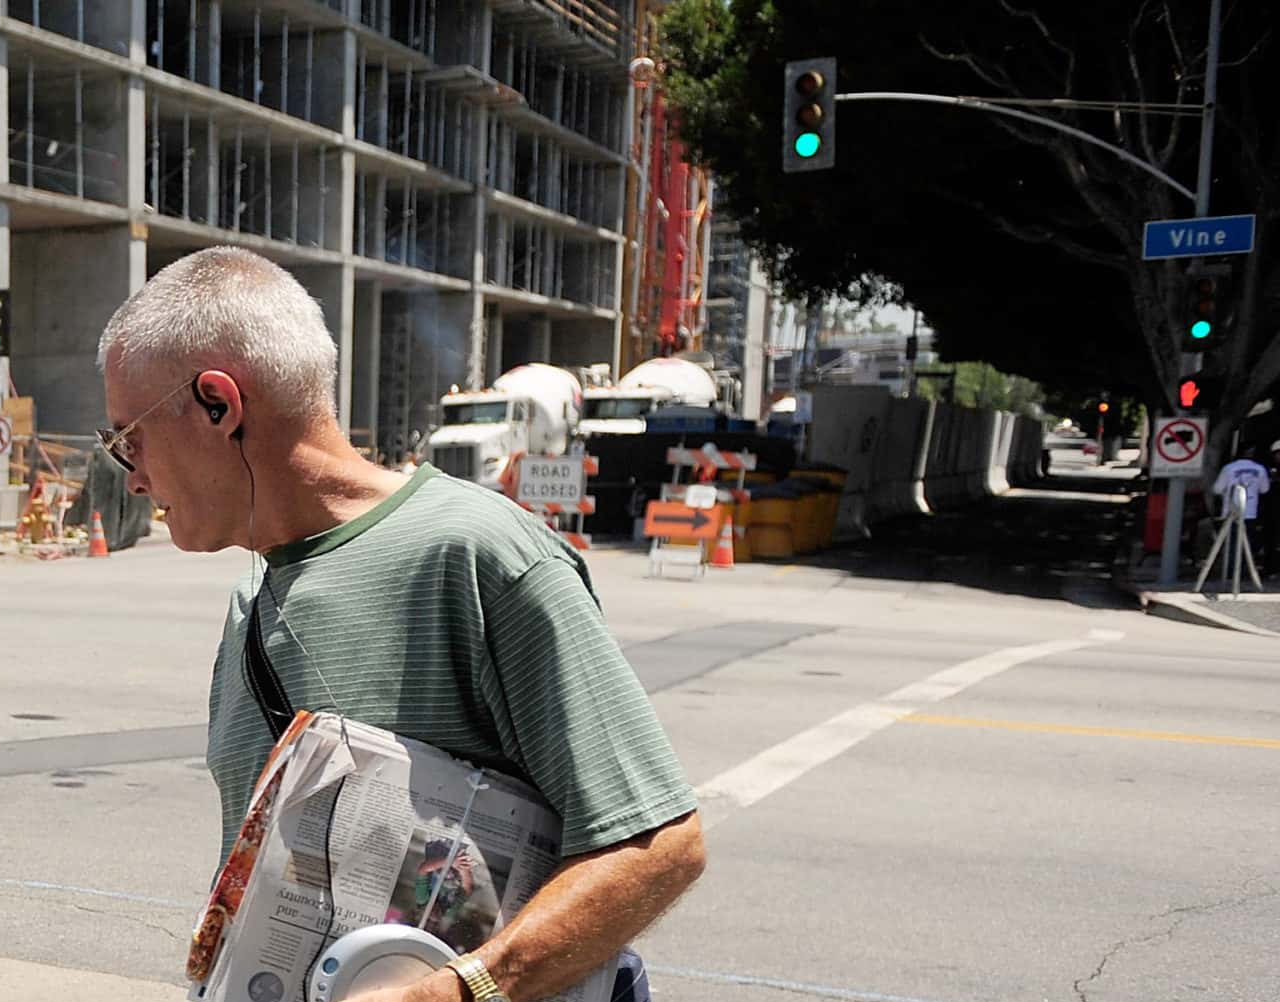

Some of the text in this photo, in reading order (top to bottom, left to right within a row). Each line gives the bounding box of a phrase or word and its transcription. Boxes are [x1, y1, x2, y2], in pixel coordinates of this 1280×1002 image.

[1170, 229, 1227, 248] Vine
[531, 465, 571, 478] ROAD
[522, 482, 577, 497] CLOSED
[276, 888, 321, 910] country
[276, 904, 299, 917] and
[342, 908, 357, 921] of
[358, 914, 379, 925] out
